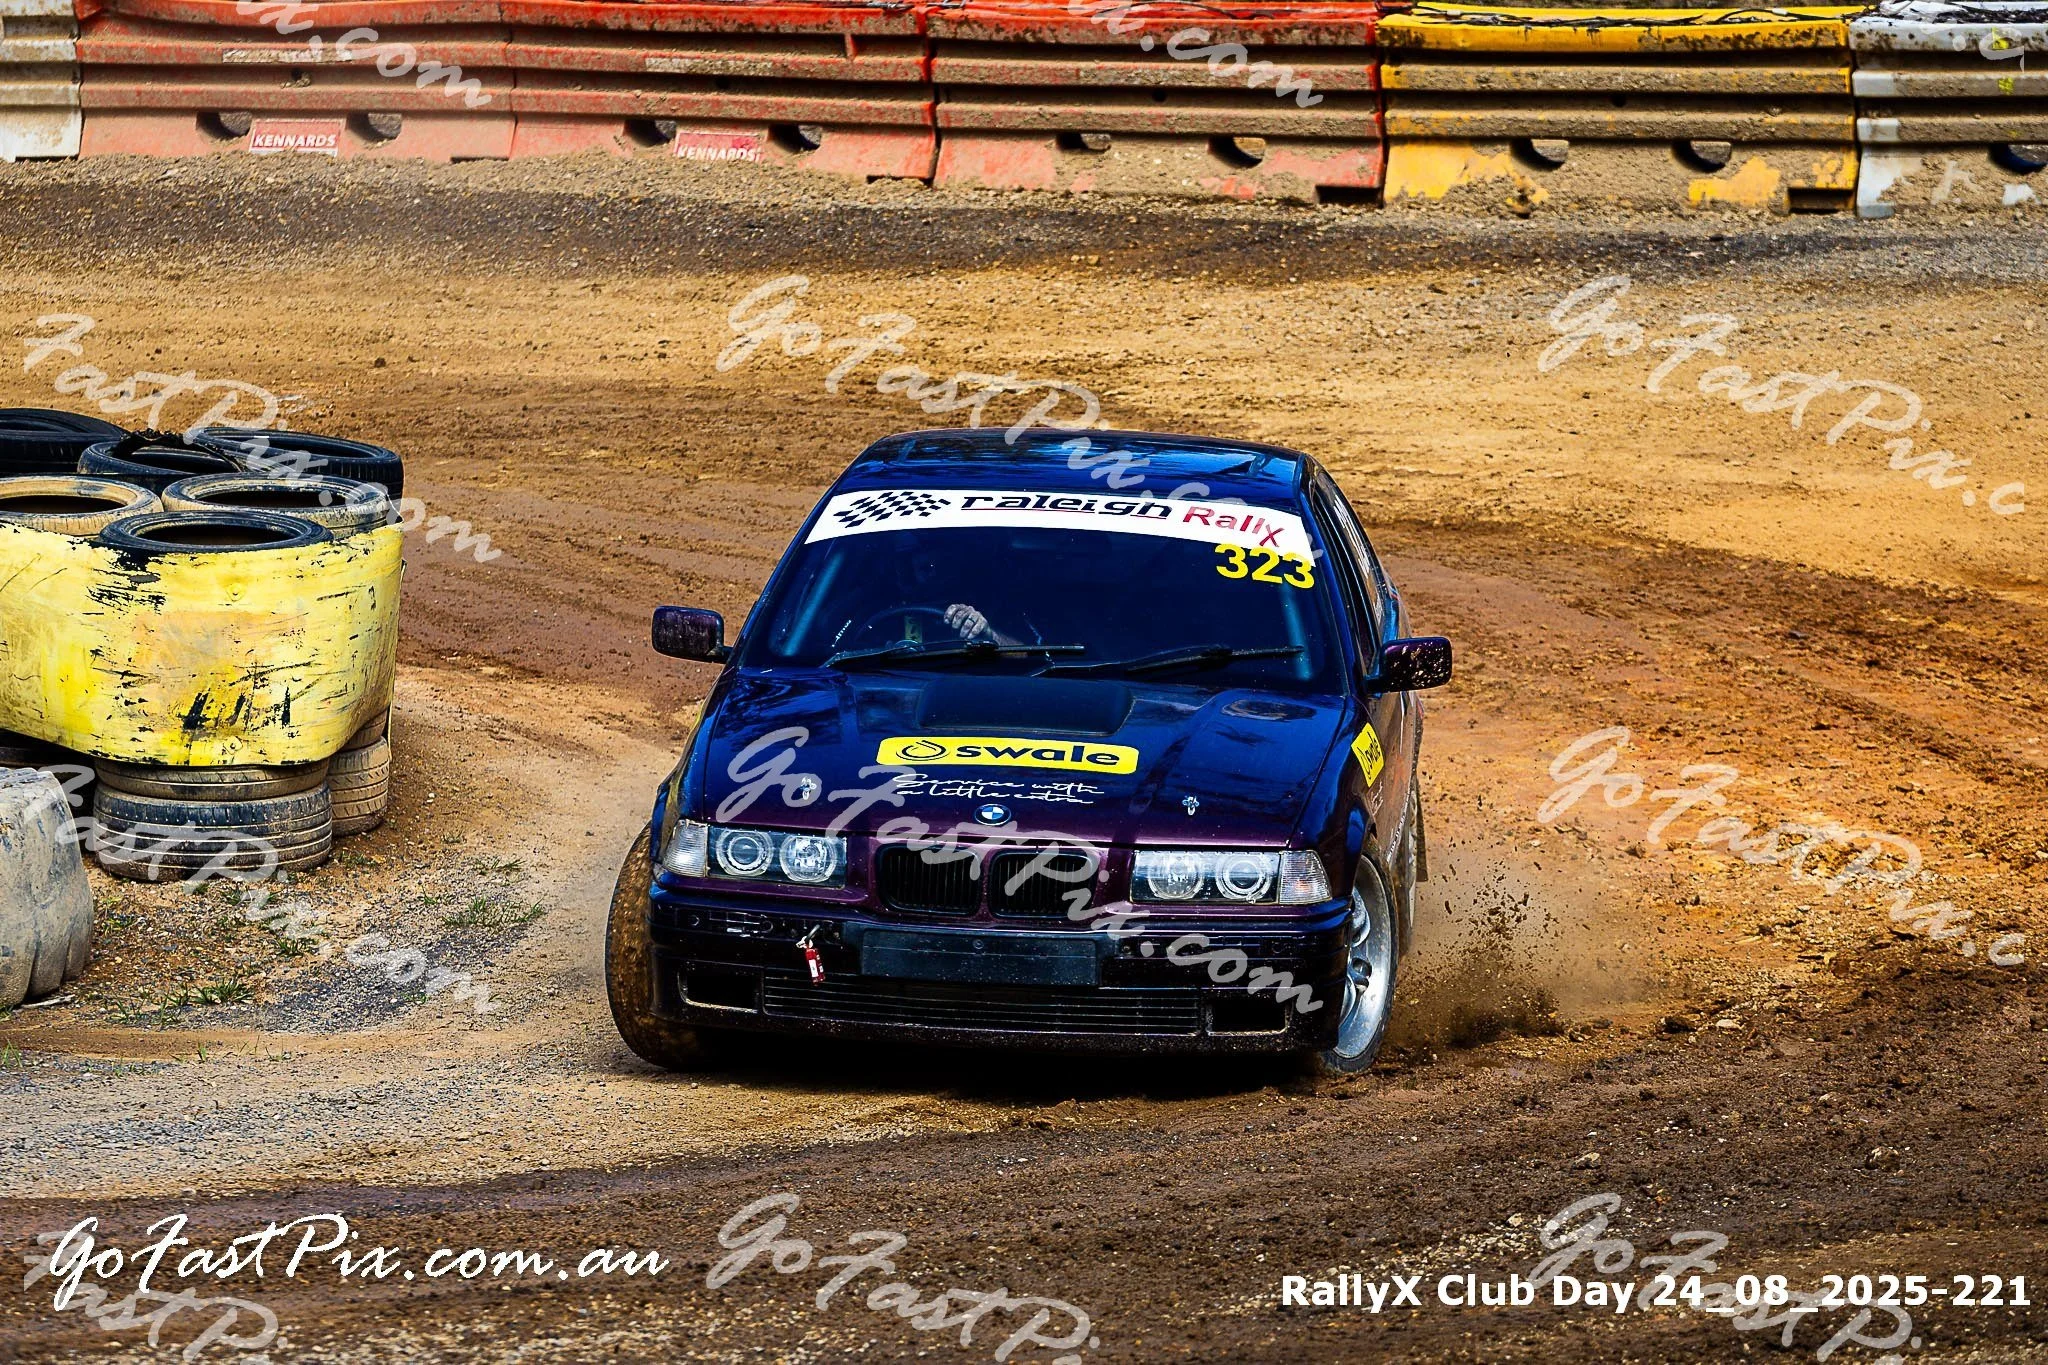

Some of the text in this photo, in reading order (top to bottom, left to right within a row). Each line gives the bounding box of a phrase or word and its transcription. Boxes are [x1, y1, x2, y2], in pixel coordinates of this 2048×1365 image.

[253, 134, 337, 147] KENNARDS
[676, 145, 757, 161] KENNARDS
[960, 495, 1173, 518] raleigh
[1214, 542, 1316, 589] 323
[956, 744, 1121, 766] swale
[892, 773, 1105, 795] Service with
[928, 782, 1011, 800] little
